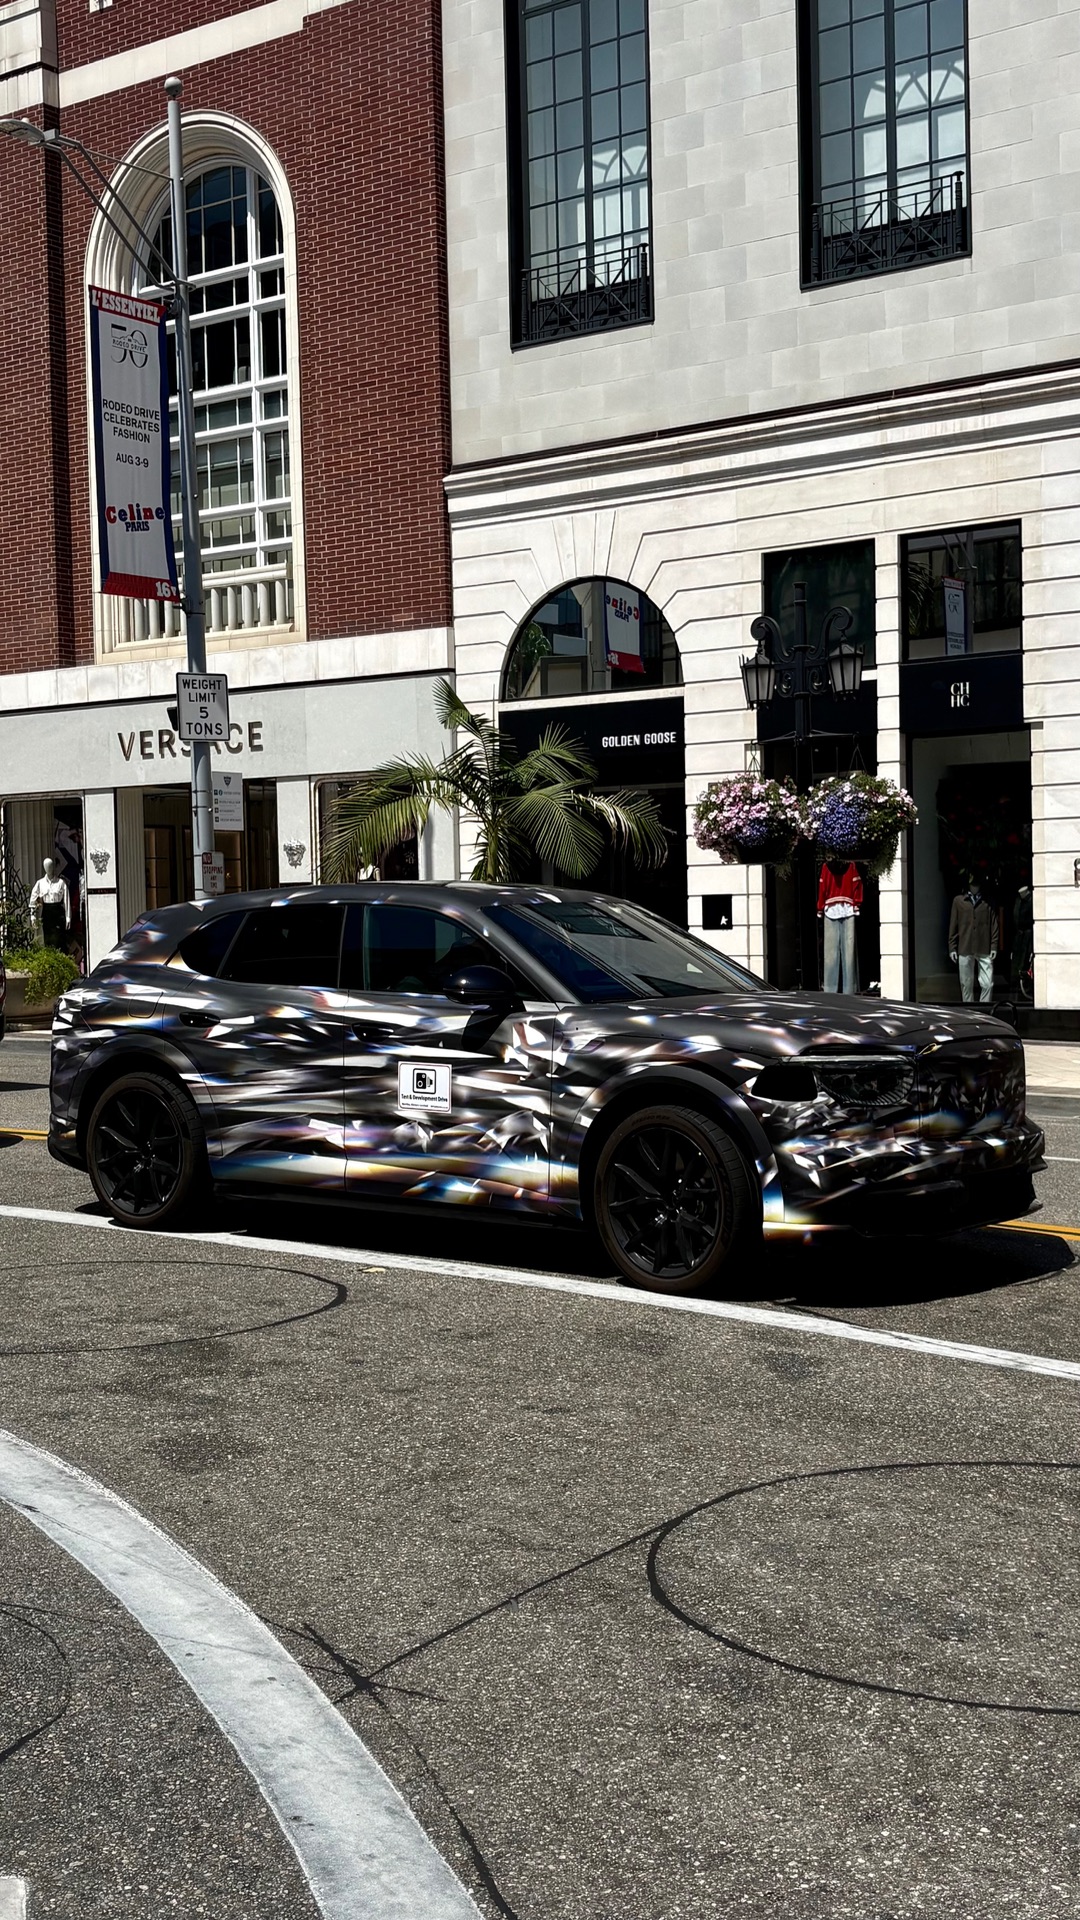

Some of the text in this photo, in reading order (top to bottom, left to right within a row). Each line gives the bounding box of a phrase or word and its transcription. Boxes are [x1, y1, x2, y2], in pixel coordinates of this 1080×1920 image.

[91, 289, 161, 324] L'ESSENTIEL
[112, 338, 147, 353] RODEO DRIVE
[102, 398, 160, 421] RODEO DRIVE
[103, 411, 160, 433] CELEBRATES
[113, 426, 150, 444] FASHION
[116, 452, 149, 468] AUG 3-9
[105, 503, 165, 524] Celine
[125, 521, 150, 532] PARIS
[182, 679, 222, 691] WEIGHT
[950, 681, 970, 695] CH
[188, 692, 217, 703] LIMIT
[950, 695, 970, 708] HC
[199, 706, 209, 719] 5
[186, 722, 223, 736] TONS
[118, 721, 264, 762] VERCE
[602, 731, 677, 748] GOLDEN GOOSE
[203, 853, 211, 864] NO
[203, 866, 223, 875] STOPPING
